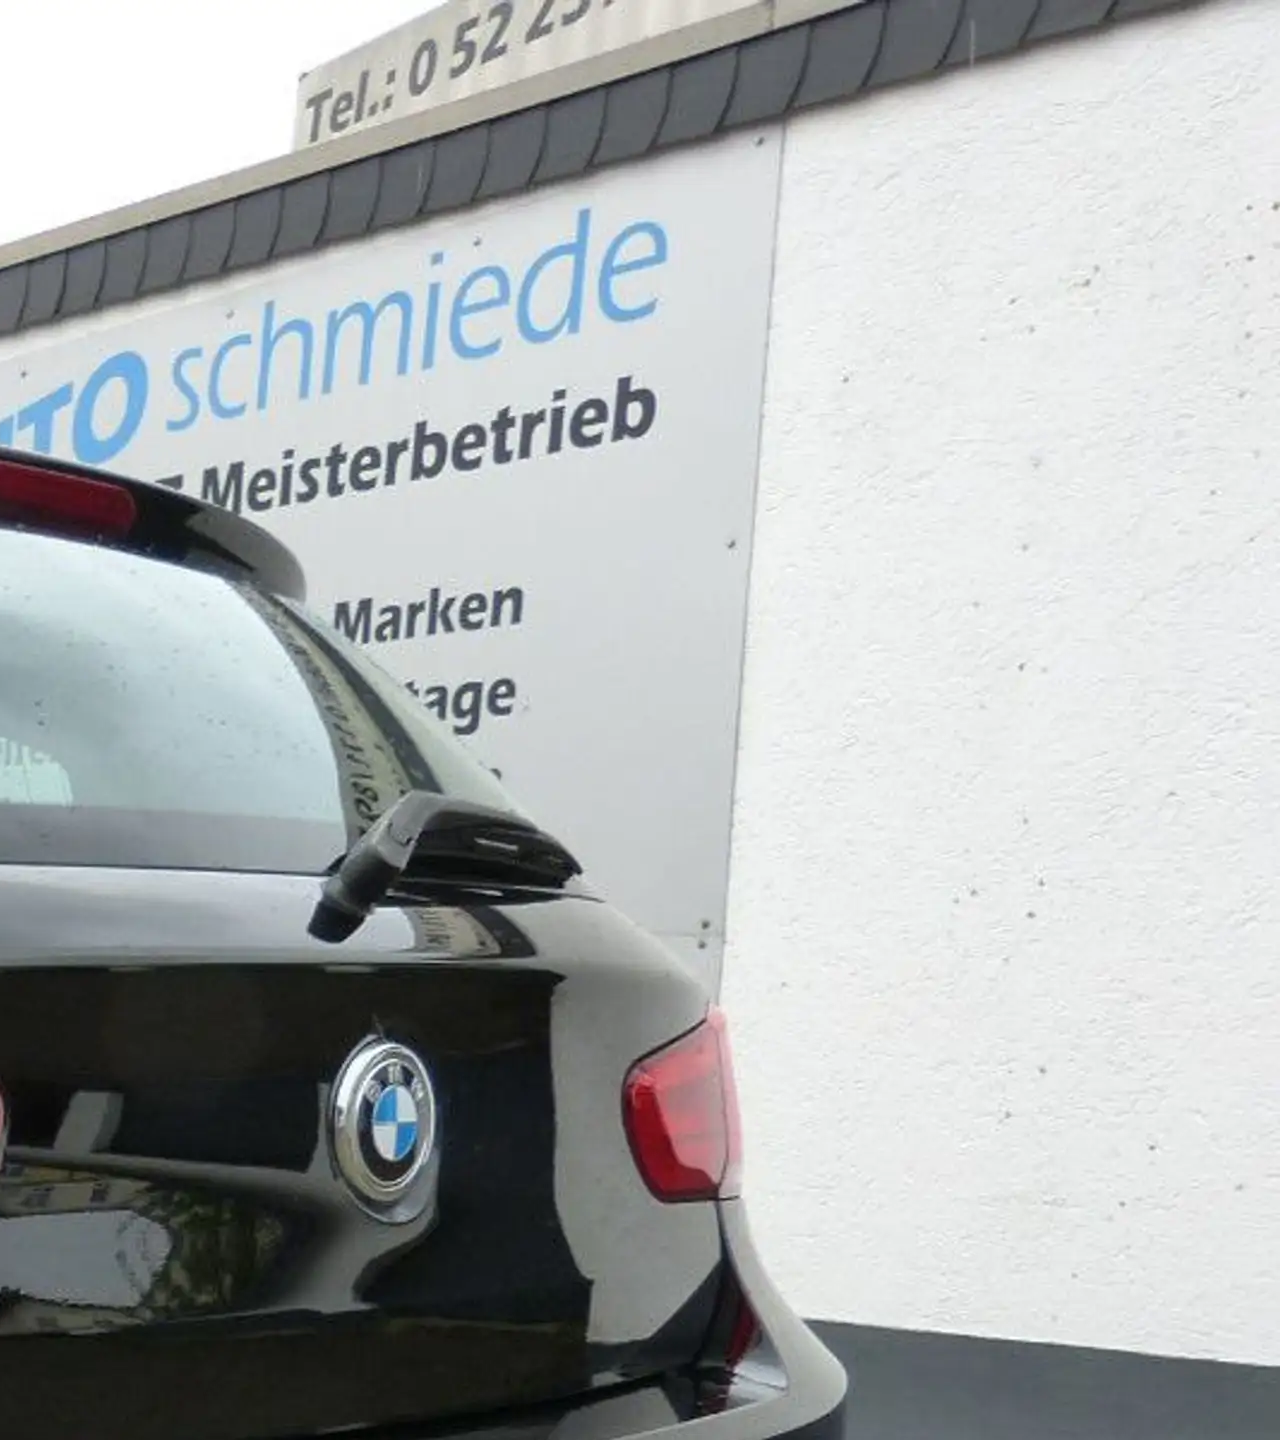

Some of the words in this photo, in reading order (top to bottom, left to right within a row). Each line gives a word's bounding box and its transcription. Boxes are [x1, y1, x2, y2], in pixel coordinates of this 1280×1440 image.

[306, 69, 395, 143] Tel.:
[200, 376, 658, 514] Meisterbetrieb
[333, 585, 525, 648] Marken
